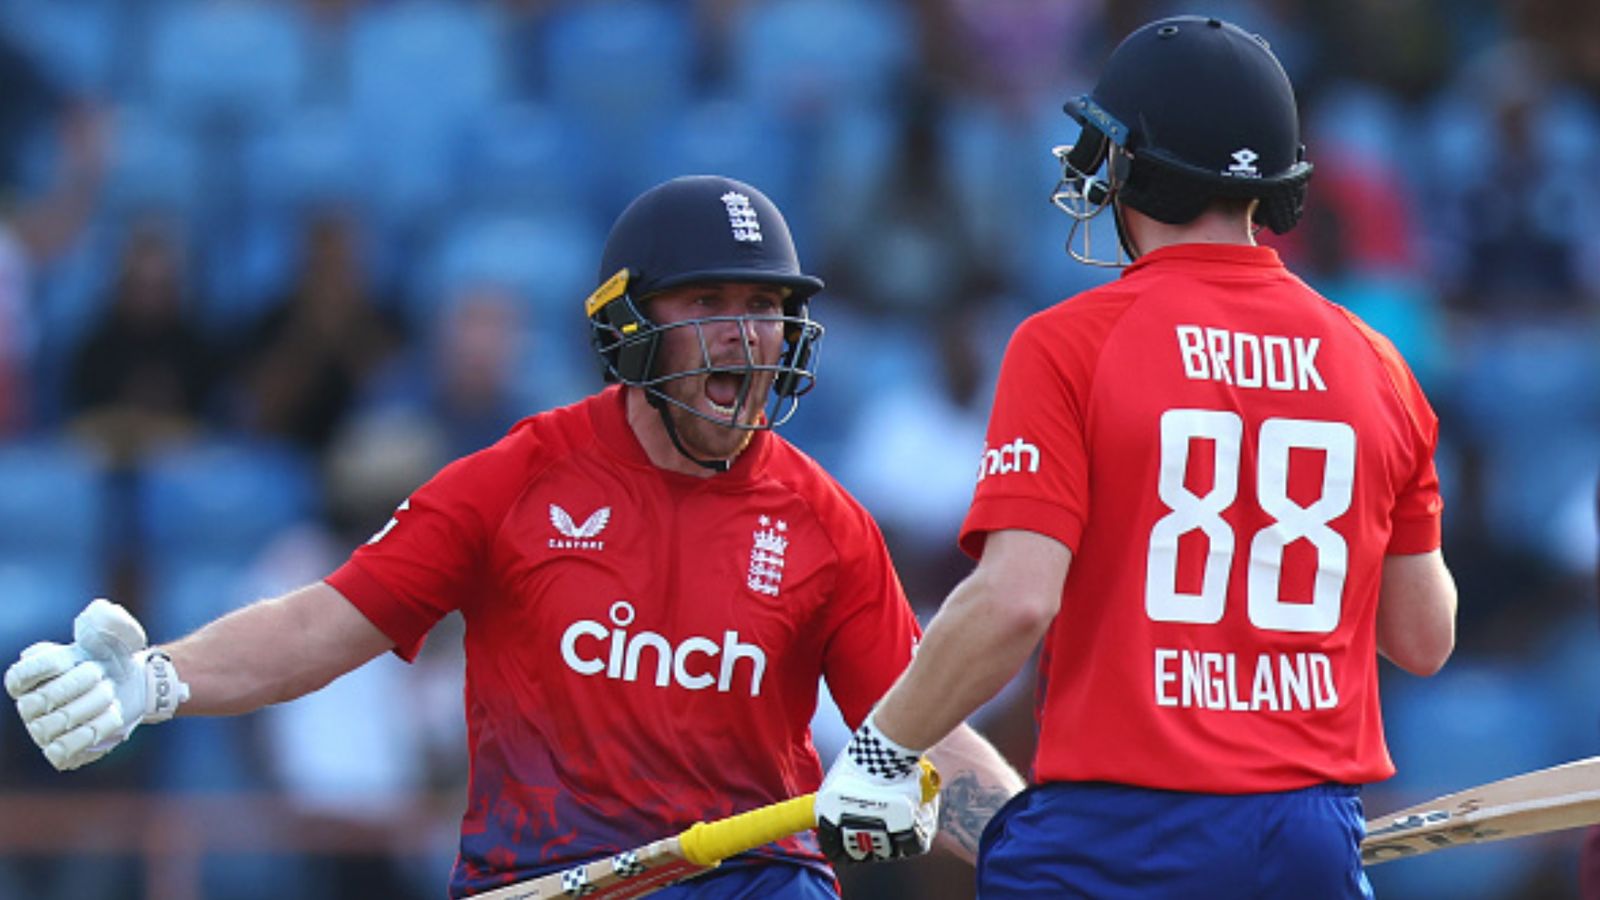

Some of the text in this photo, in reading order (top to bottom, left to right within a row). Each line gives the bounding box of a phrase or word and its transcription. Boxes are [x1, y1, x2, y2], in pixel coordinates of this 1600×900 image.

[1175, 325, 1328, 391] BROOK
[978, 437, 1040, 481] inch
[1145, 408, 1357, 633] 88
[560, 601, 767, 697] cinch
[1155, 647, 1339, 712] ENGLAND
